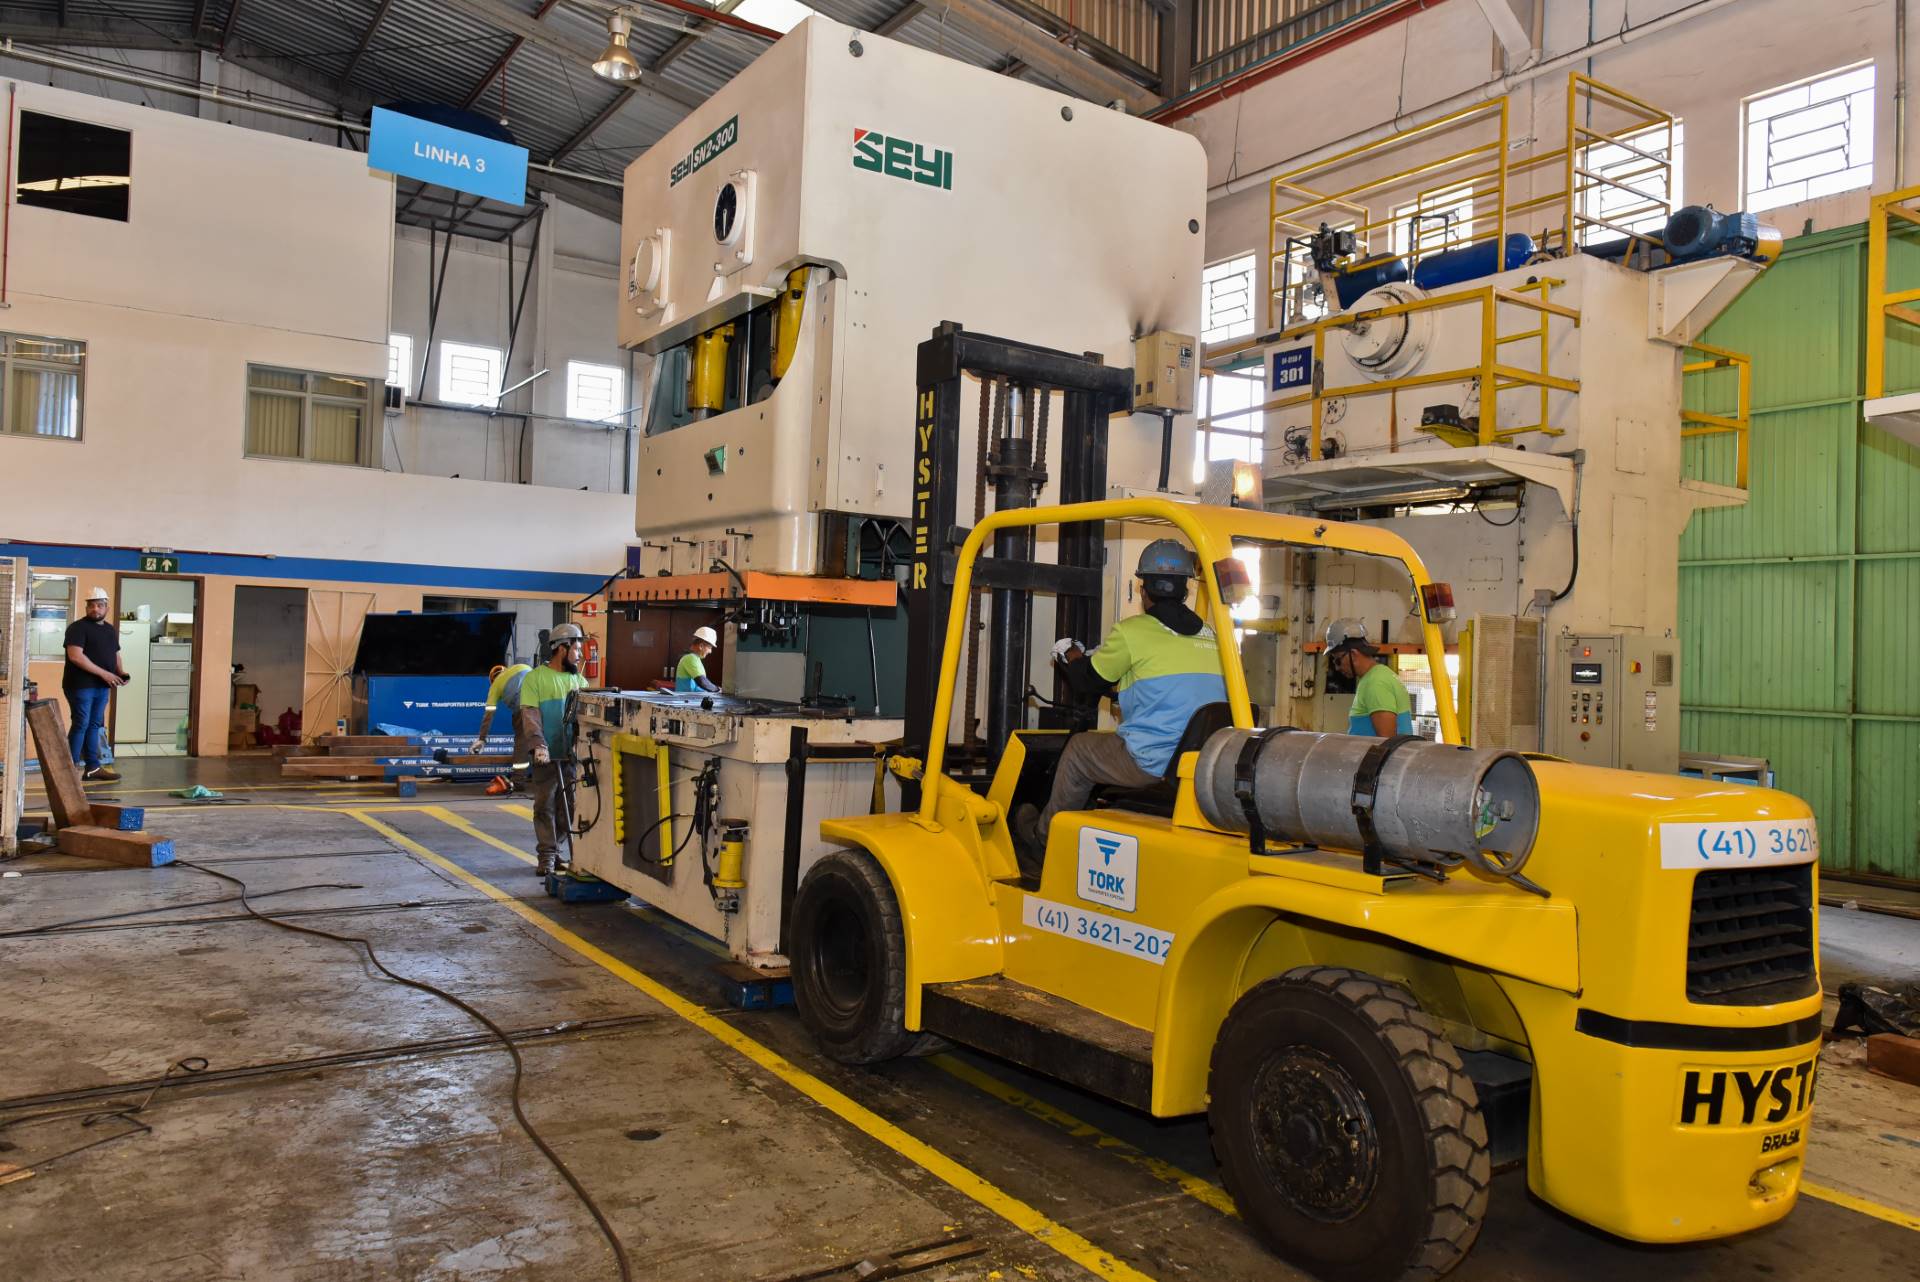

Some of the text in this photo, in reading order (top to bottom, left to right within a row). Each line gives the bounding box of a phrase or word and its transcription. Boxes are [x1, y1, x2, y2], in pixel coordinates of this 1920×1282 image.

[413, 141, 486, 174] LINHA 3
[670, 122, 735, 188] SEYI SN2-300
[853, 128, 953, 190] SEYI
[1280, 366, 1304, 384] 301
[913, 390, 934, 590] HYSTER
[1697, 828, 1756, 860] (41)
[1088, 868, 1126, 895] TORK
[1037, 905, 1069, 933] (41)
